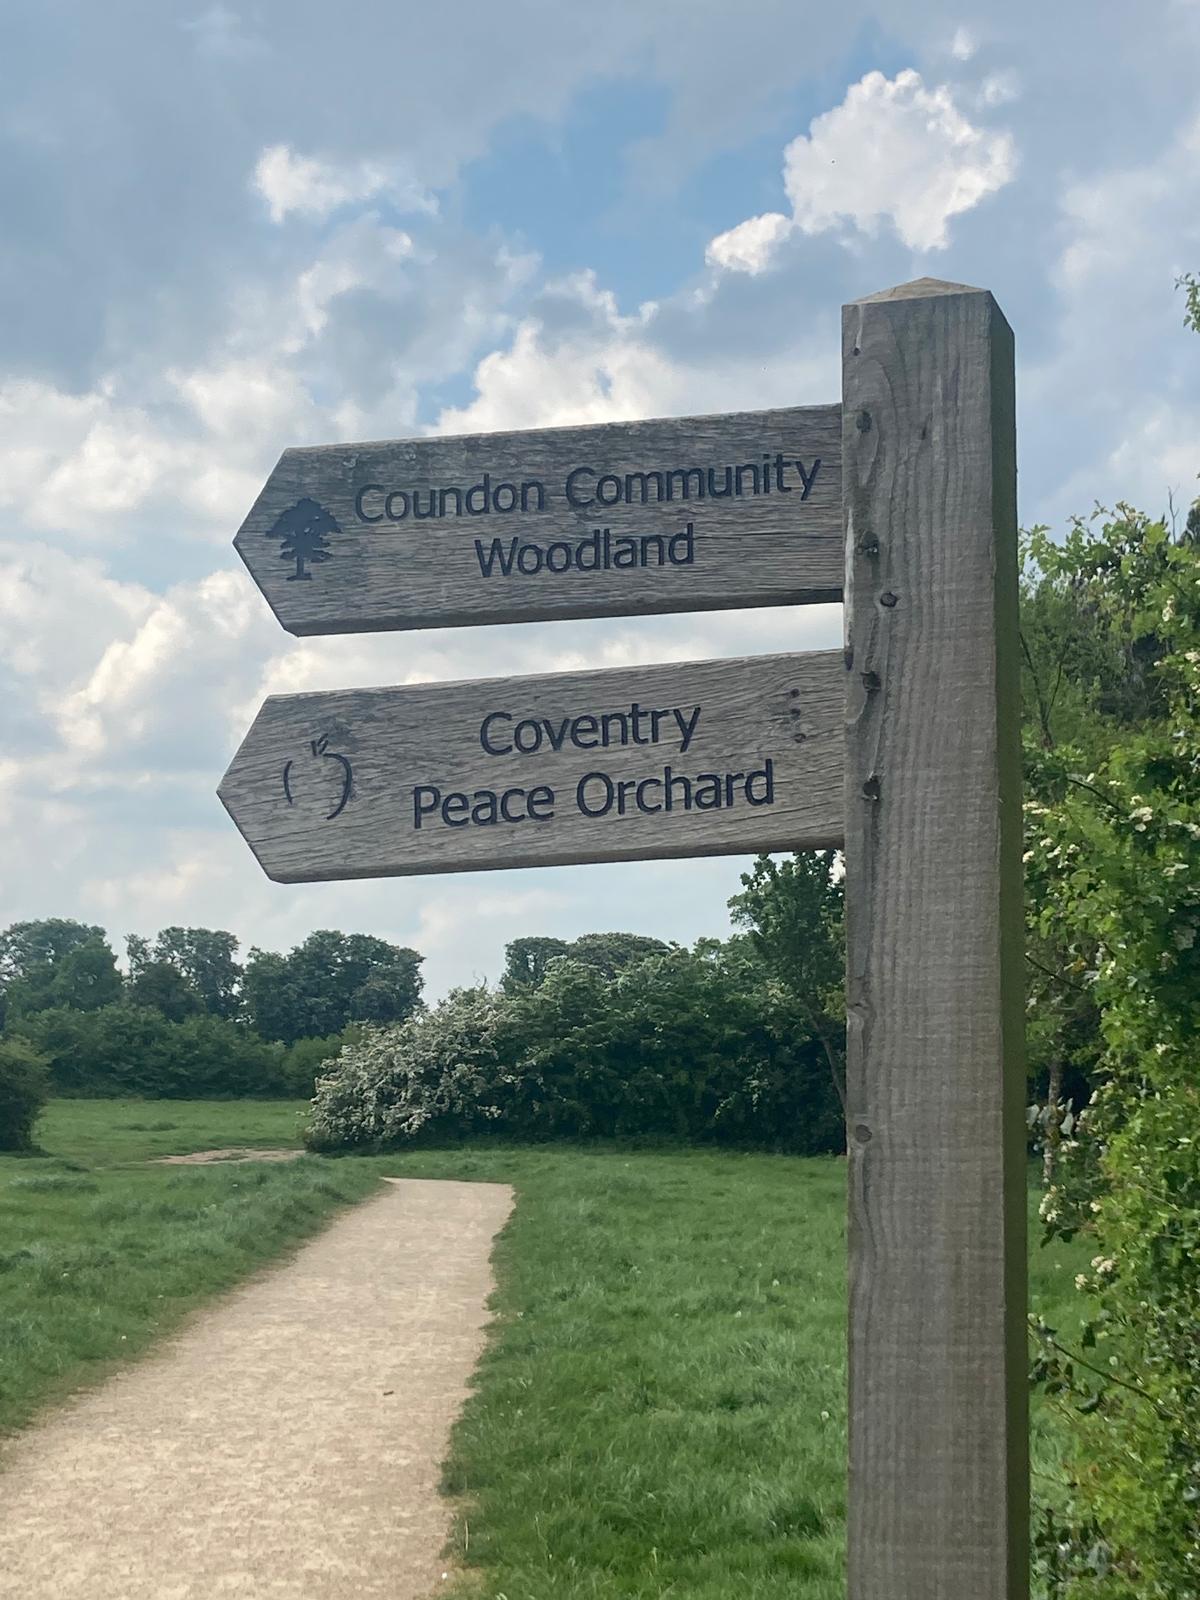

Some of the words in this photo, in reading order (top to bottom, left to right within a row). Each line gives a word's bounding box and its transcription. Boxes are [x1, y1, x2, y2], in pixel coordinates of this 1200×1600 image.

[355, 473, 545, 523] Coundon
[565, 453, 821, 510] Community
[474, 523, 695, 578] Woodland
[480, 703, 701, 755] Coventry
[413, 784, 555, 829] Peace
[576, 759, 774, 818] Orchard
